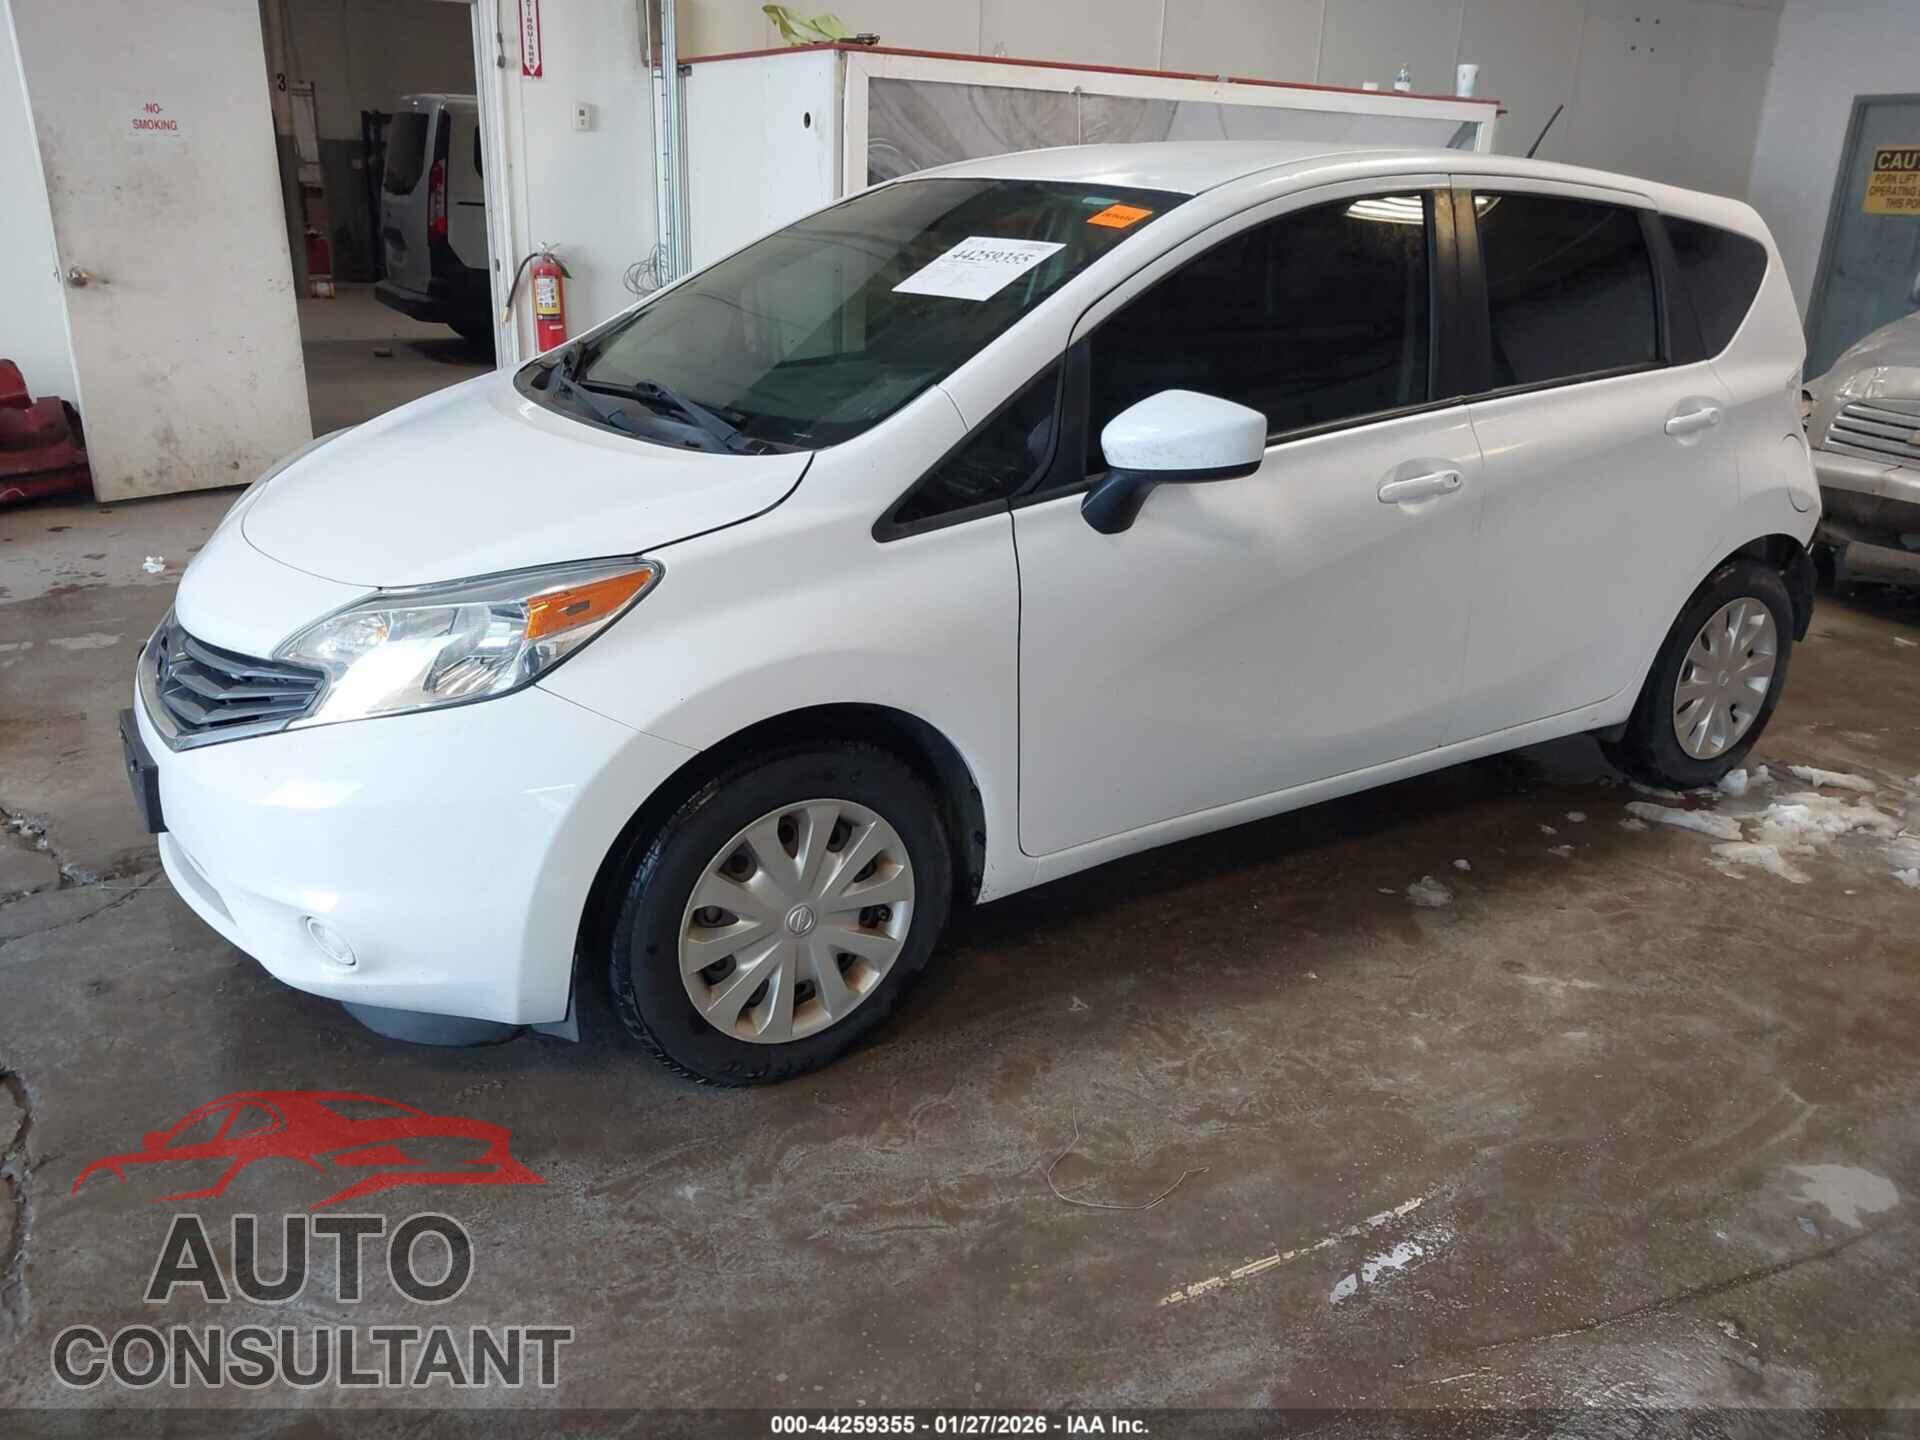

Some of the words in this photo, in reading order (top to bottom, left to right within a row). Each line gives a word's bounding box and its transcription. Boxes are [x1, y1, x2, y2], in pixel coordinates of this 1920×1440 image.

[276, 73, 286, 92] 3
[132, 118, 178, 130] SMOKING
[1878, 152, 1920, 169] CAU
